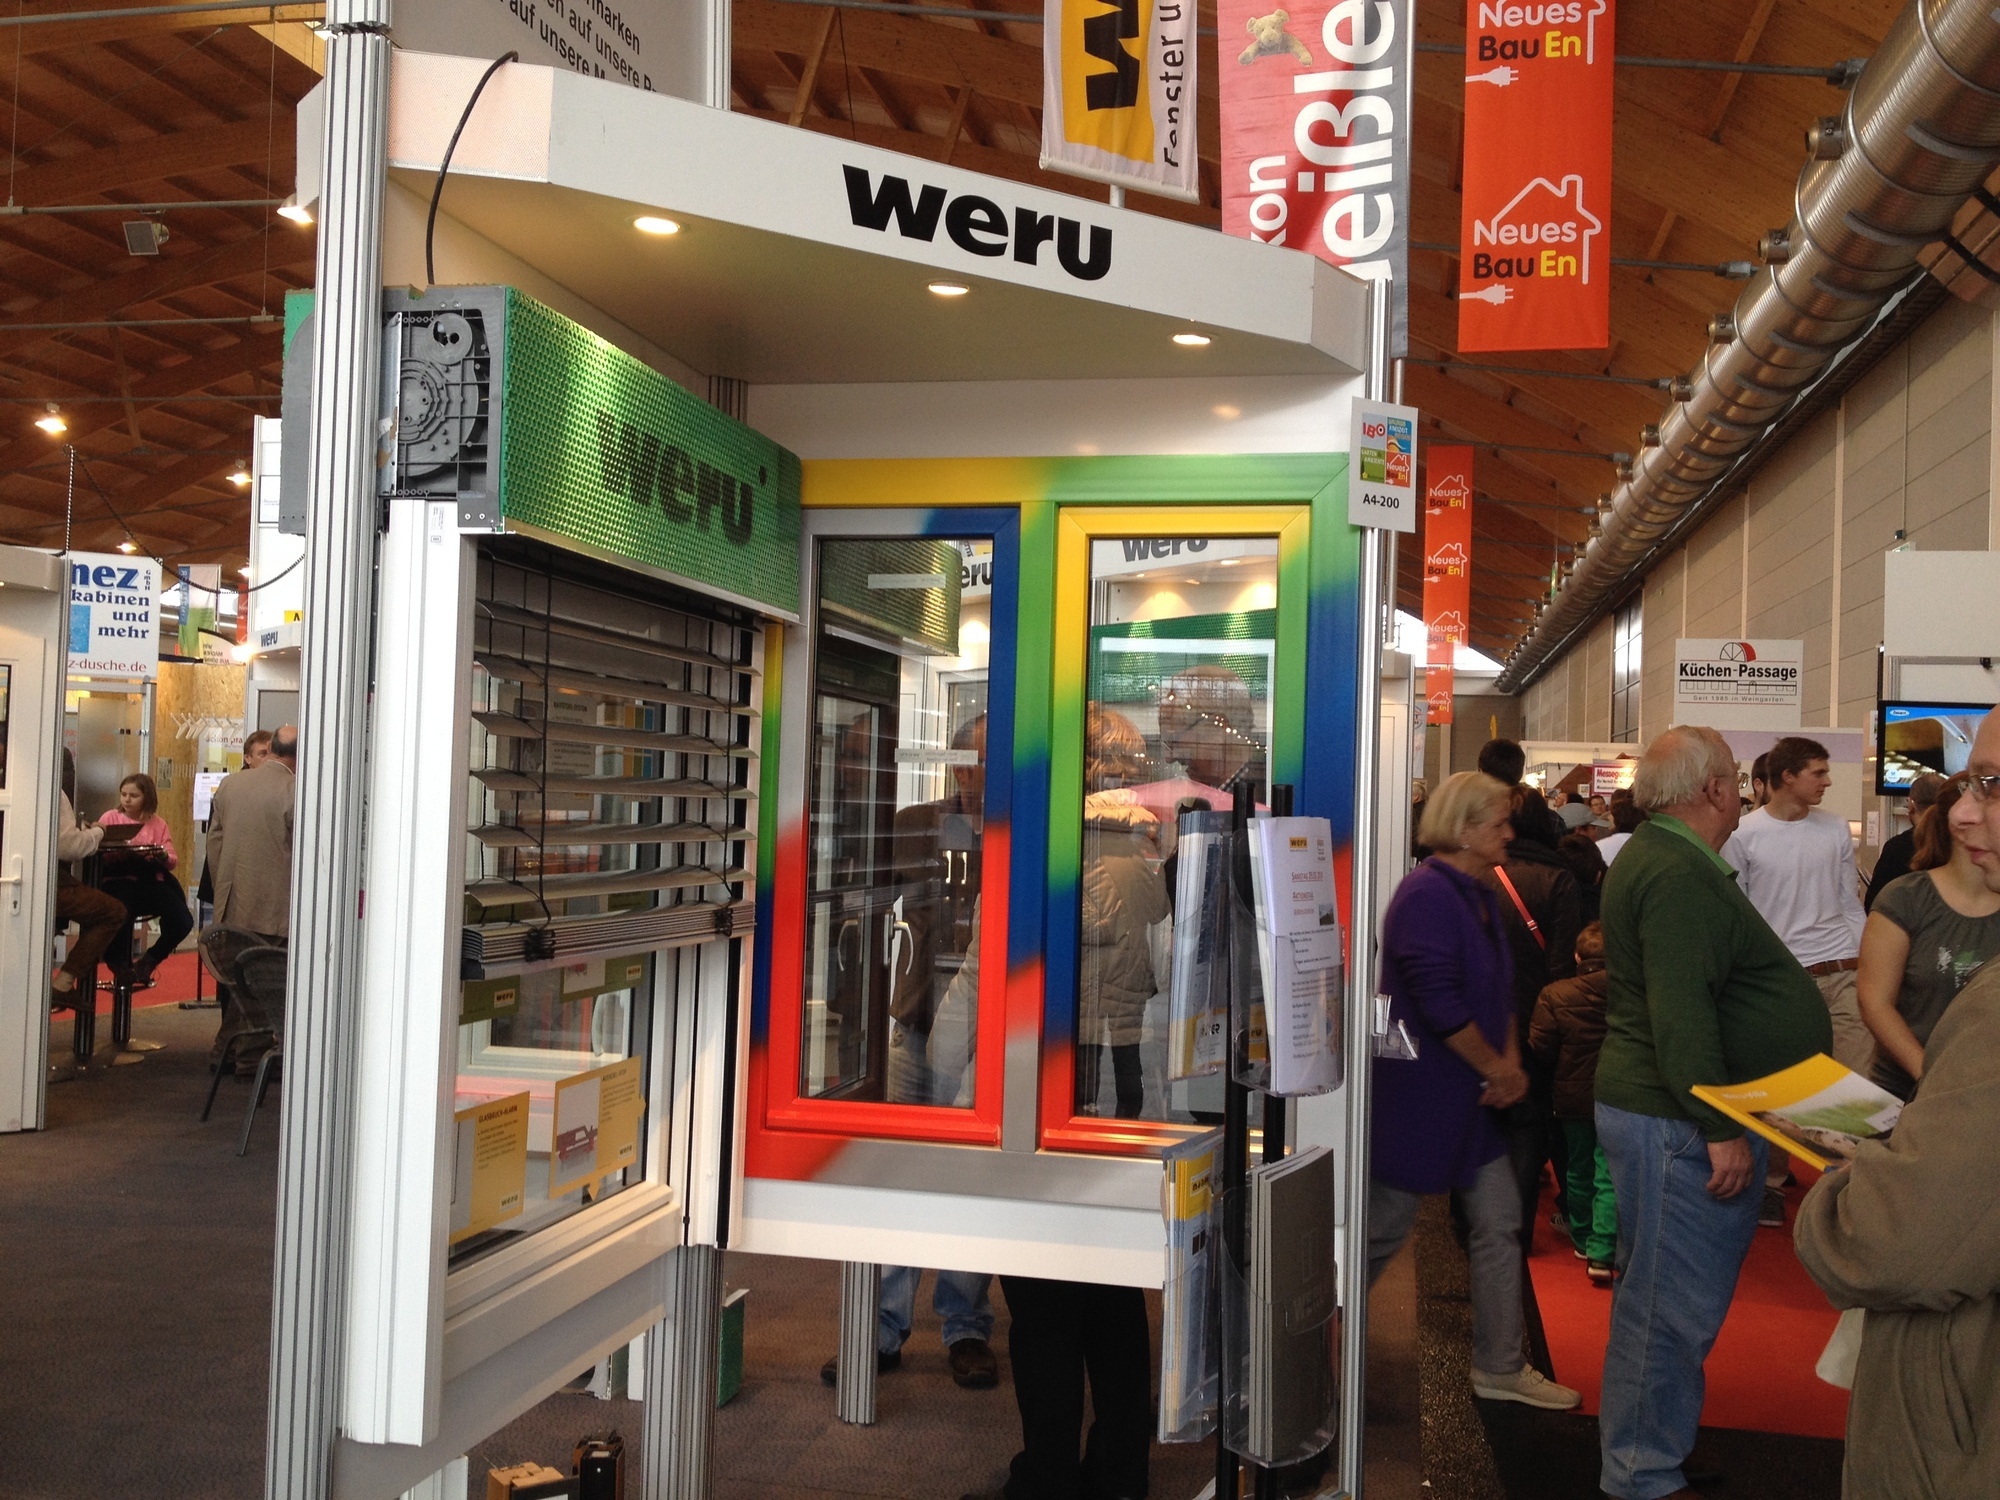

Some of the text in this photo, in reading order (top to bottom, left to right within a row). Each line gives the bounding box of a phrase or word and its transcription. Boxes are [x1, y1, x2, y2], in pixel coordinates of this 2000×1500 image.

[1478, 2, 1582, 29] Neues
[509, 0, 590, 76] auf unsere
[569, 8, 592, 43] auf
[595, 32, 640, 88] unsere
[1159, 35, 1184, 167] Fenster
[842, 163, 1113, 281] weru
[1473, 219, 1578, 246] Neues
[597, 409, 755, 548] weru
[1429, 487, 1462, 497] Neues
[1362, 493, 1400, 509] A4-200
[1428, 555, 1461, 565] Neues
[112, 610, 149, 623] und
[98, 626, 149, 639] mehr
[1426, 622, 1459, 633] Neues
[261, 631, 279, 648] weru
[1680, 663, 1798, 681] Küchen-Passage
[1693, 694, 1709, 702] Seit
[1741, 695, 1784, 703] Weingarten
